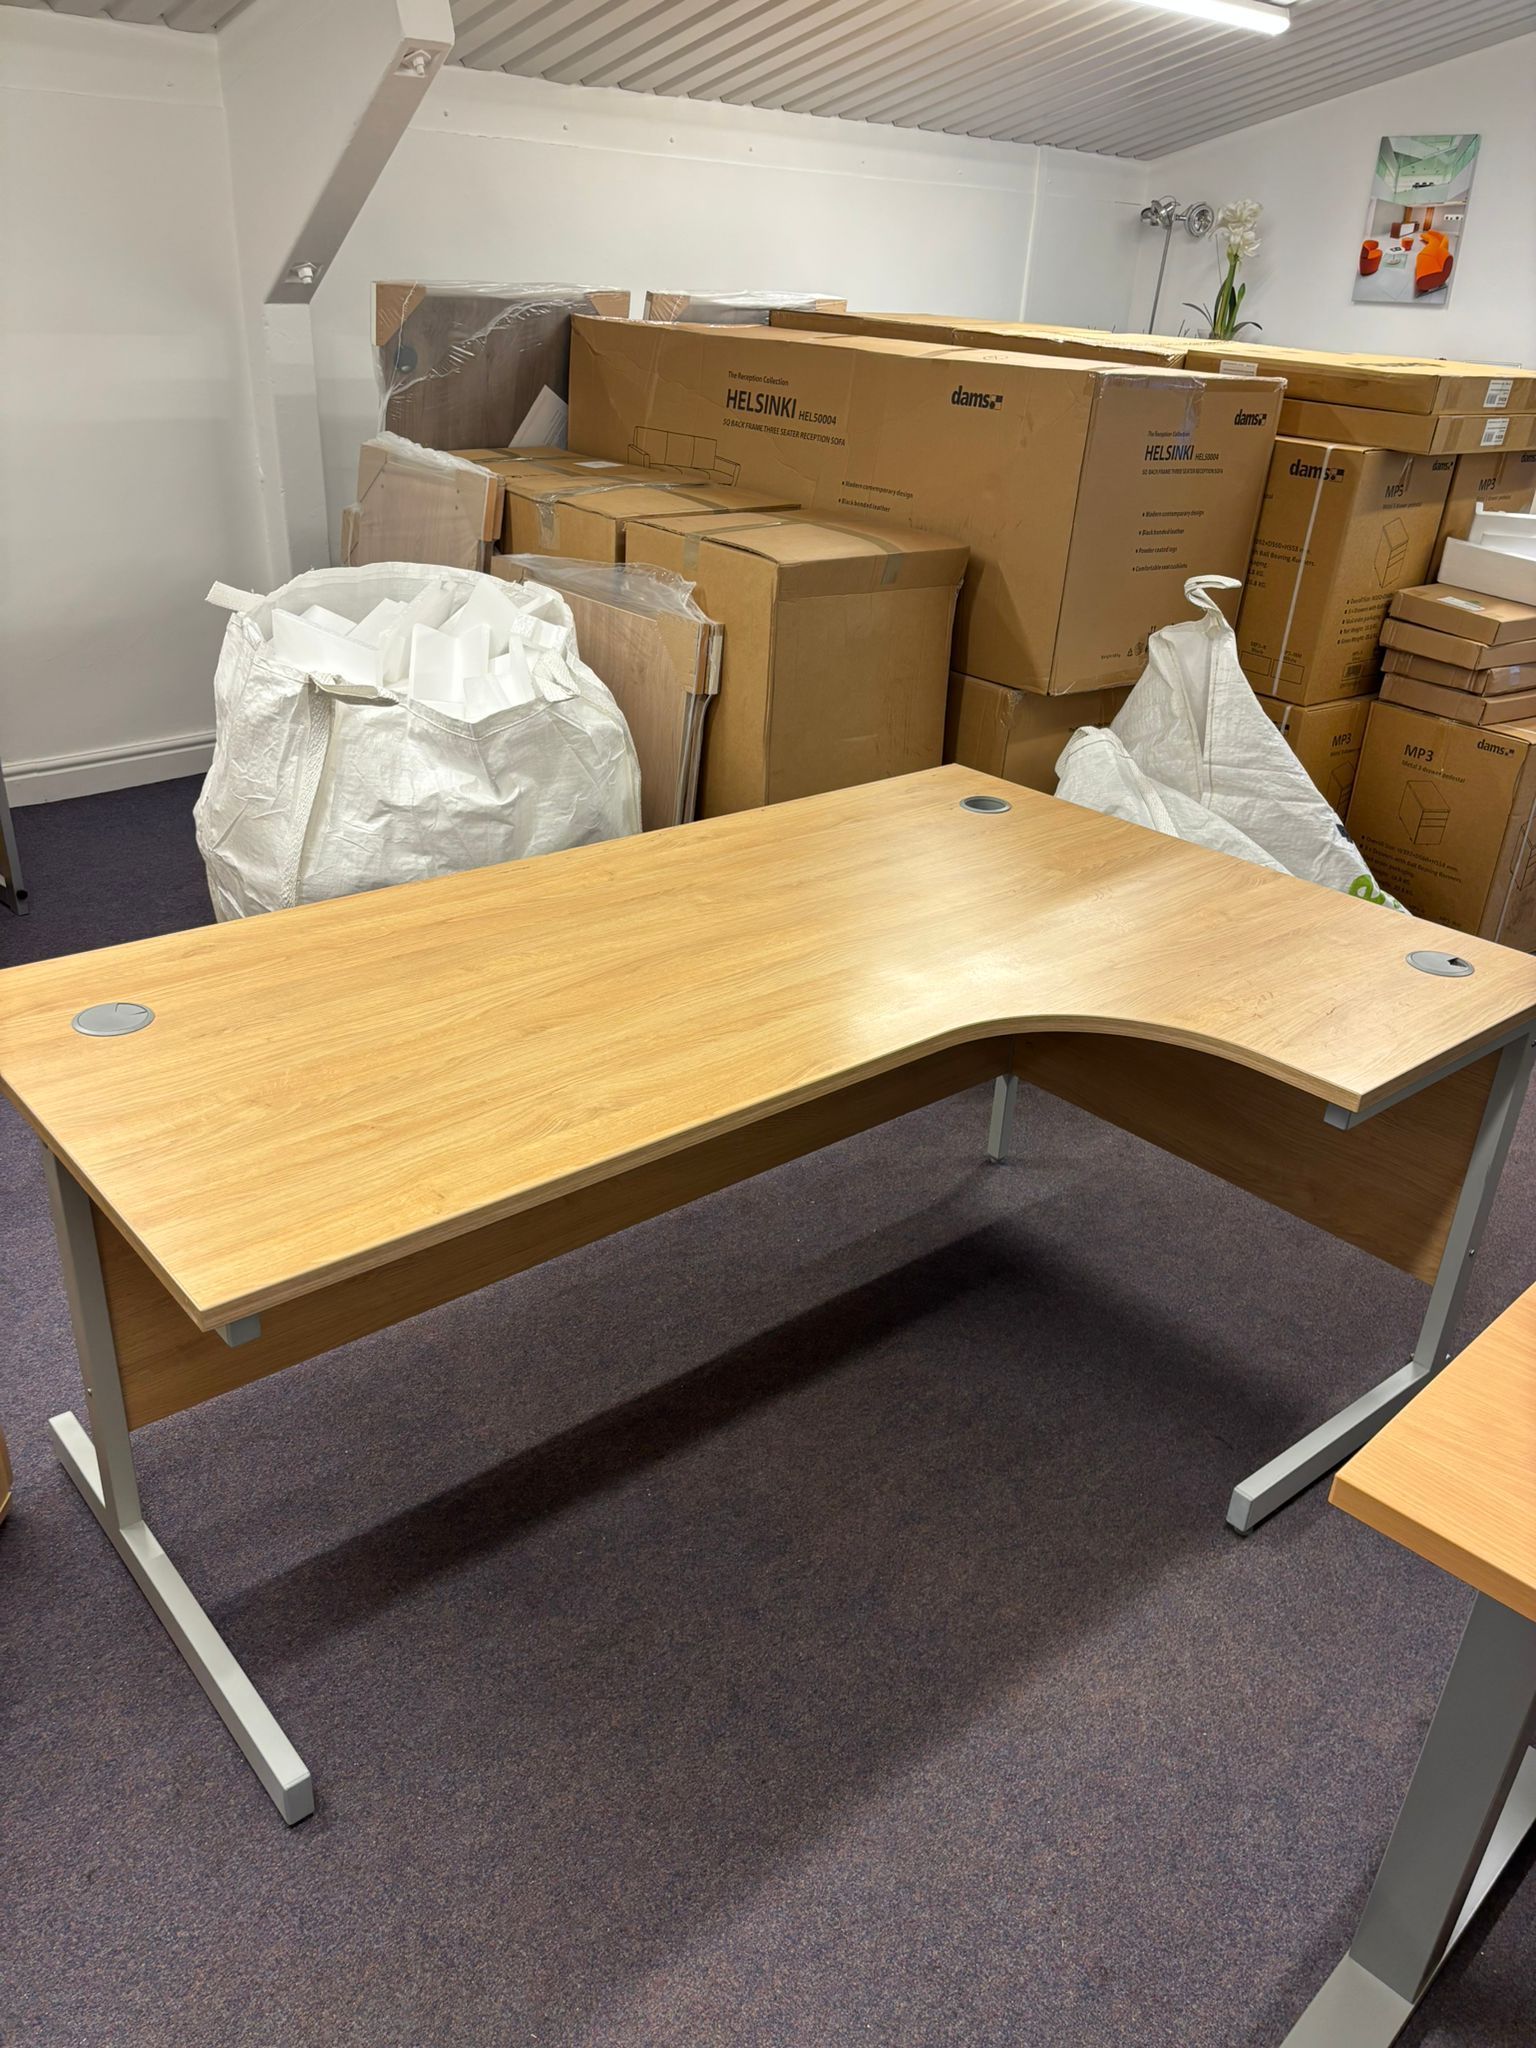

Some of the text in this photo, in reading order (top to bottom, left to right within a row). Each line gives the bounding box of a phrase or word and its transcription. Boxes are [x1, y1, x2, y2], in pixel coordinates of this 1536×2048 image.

[728, 371, 789, 386] The Reception Collection
[726, 388, 797, 419] HELSINKI
[730, 419, 746, 429] BACK
[745, 421, 764, 432] FRAME
[764, 425, 779, 435] THREE
[780, 428, 800, 438] SEATER
[800, 431, 831, 444] RECEPTION
[830, 436, 846, 447] SOFA
[1144, 445, 1195, 461] HELSINKI
[845, 480, 913, 500] Modern contemporary design
[1478, 477, 1497, 491] MP3
[1331, 732, 1352, 748] MP3
[1403, 743, 1434, 763] MP3
[1401, 759, 1418, 769] Metal
[1422, 766, 1442, 776] drawer
[1442, 772, 1466, 784] pedestal
